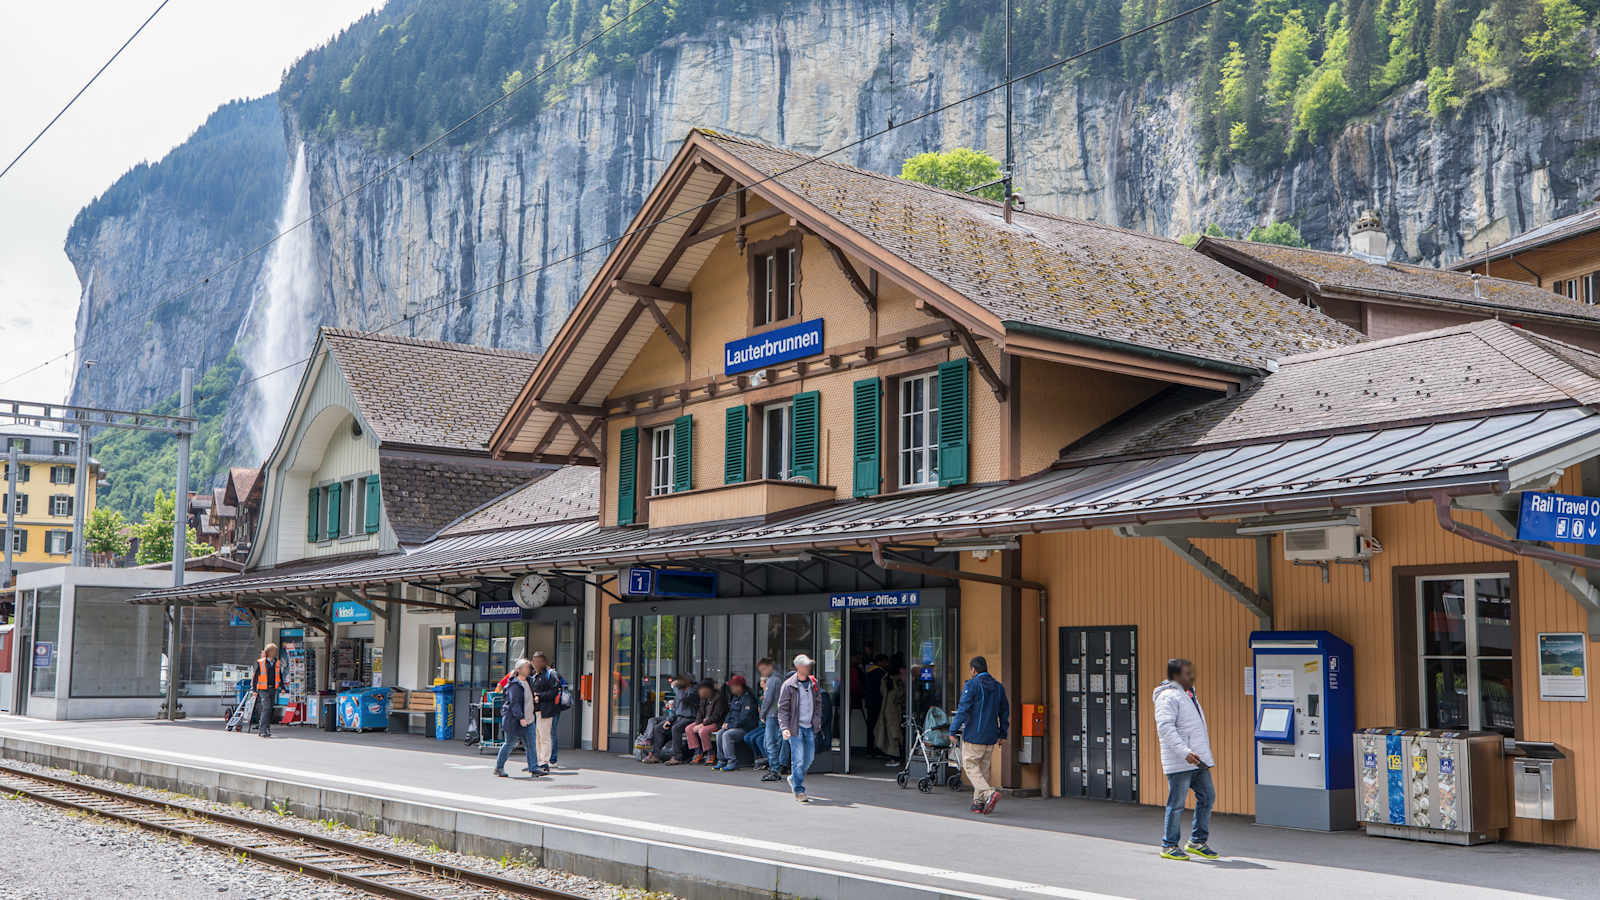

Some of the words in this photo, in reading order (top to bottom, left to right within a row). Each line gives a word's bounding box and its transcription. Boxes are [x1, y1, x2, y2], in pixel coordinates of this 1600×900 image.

[727, 330, 819, 367] Lauterbrunnen
[1531, 495, 1554, 512] Rail
[1556, 497, 1588, 515] Travel
[637, 576, 643, 591] 1
[831, 597, 846, 607] Rail
[848, 596, 869, 606] Travel
[875, 594, 898, 605] Office
[481, 604, 520, 616] Lauterbrunnen
